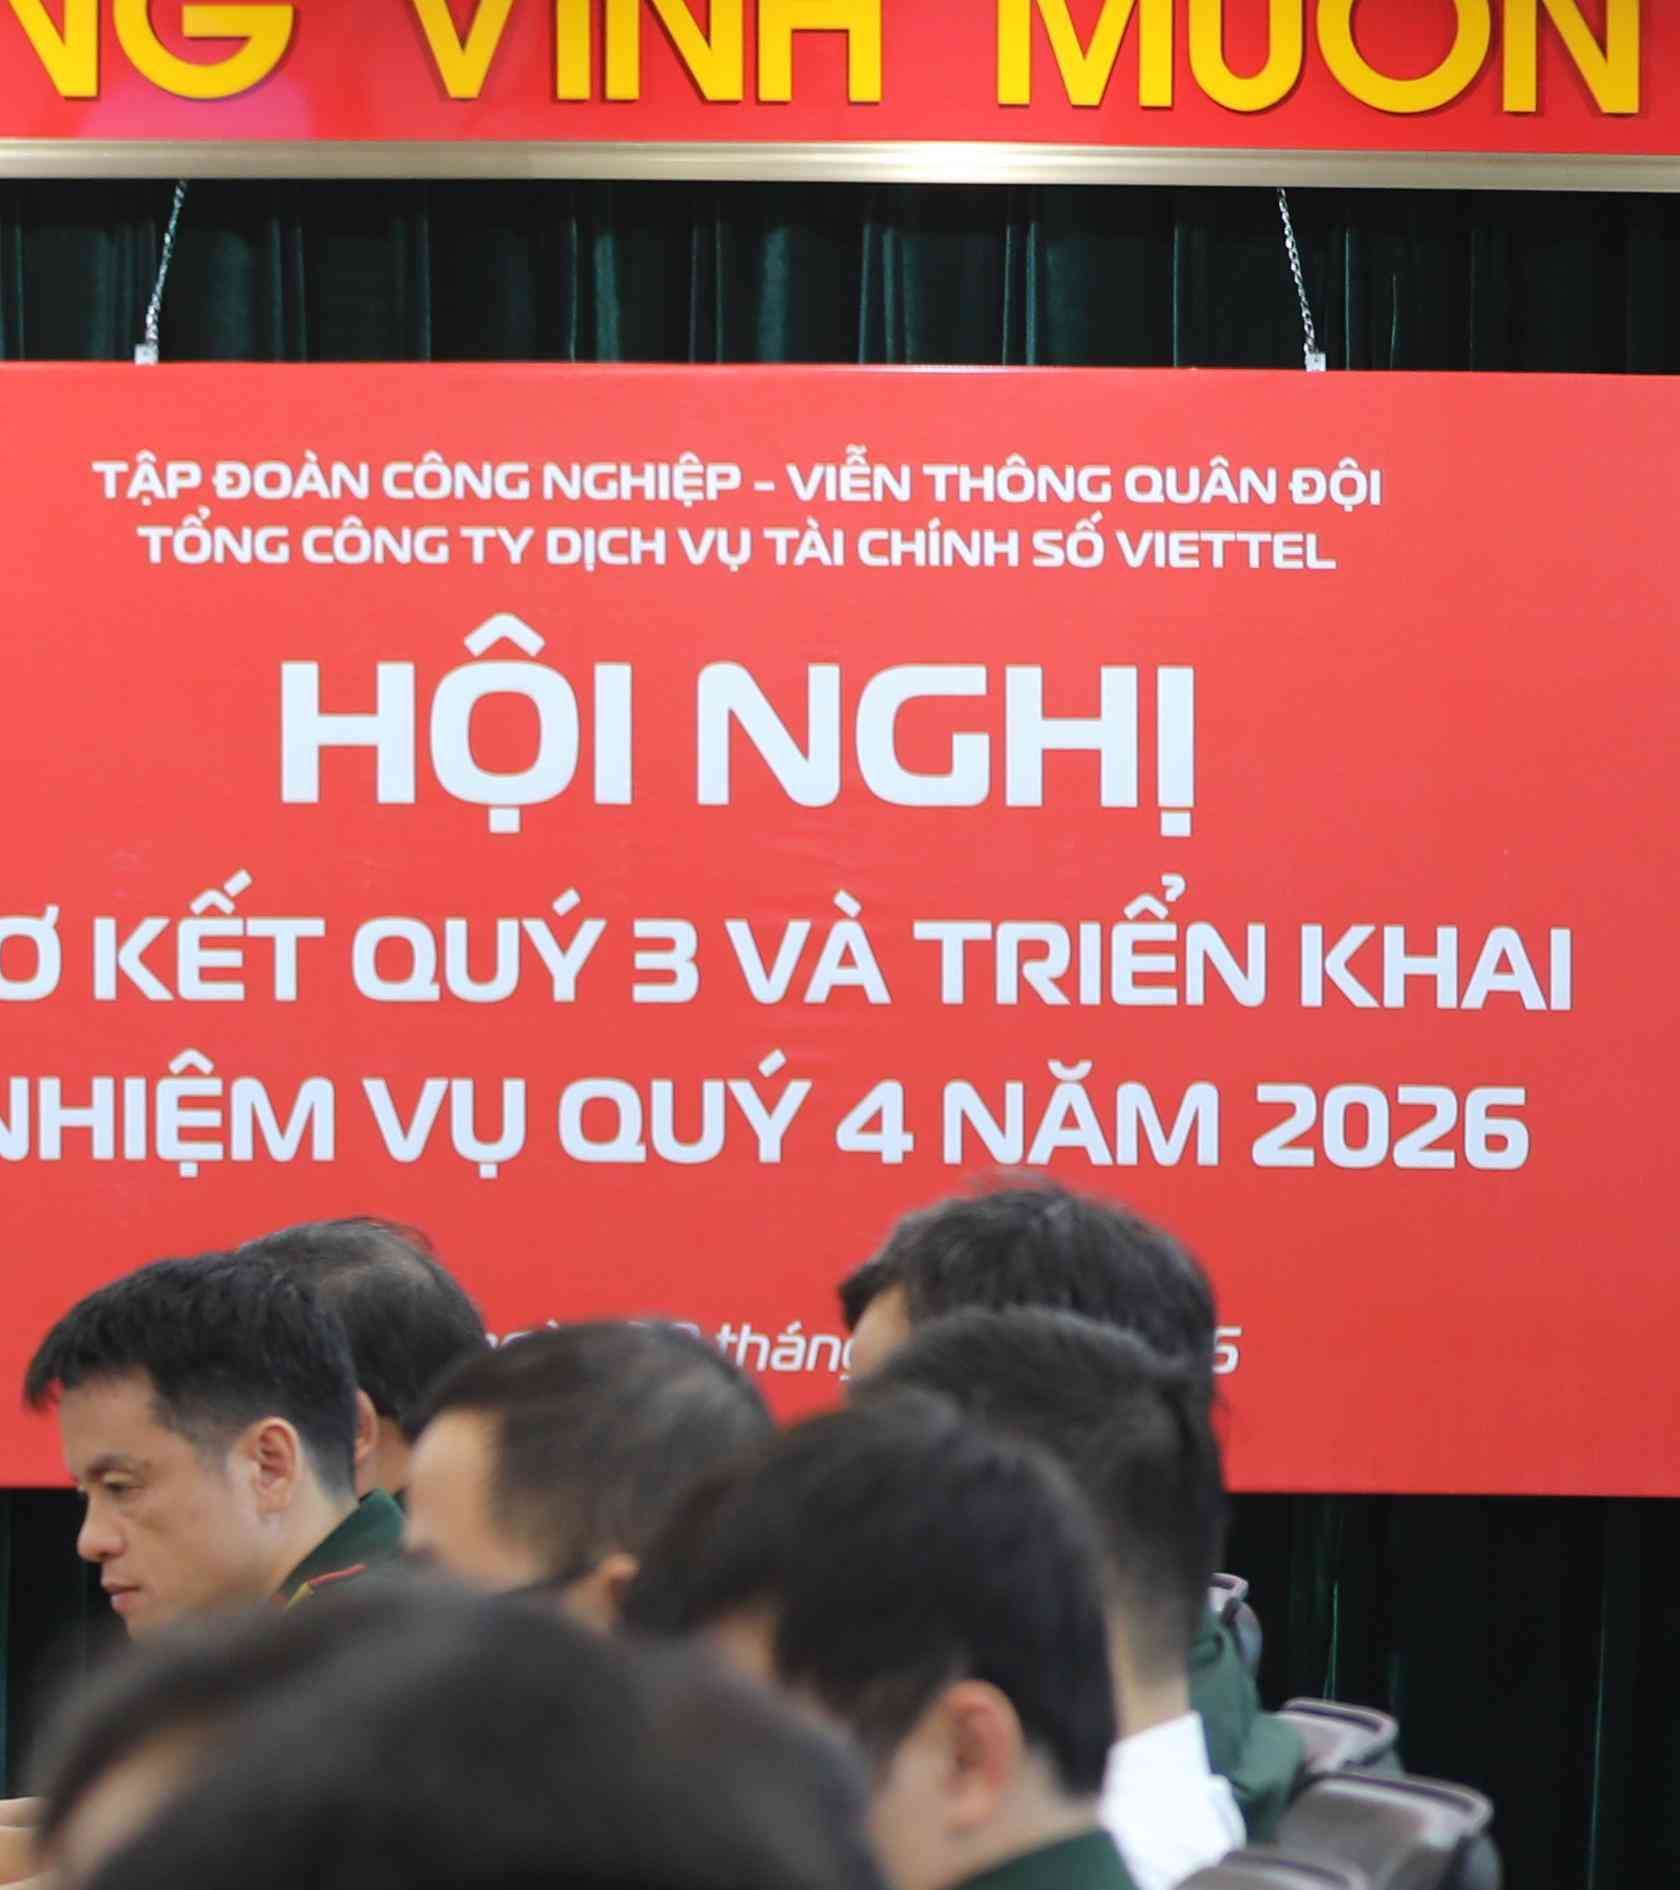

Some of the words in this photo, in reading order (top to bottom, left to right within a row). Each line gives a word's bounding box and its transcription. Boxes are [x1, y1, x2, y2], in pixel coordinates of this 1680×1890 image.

[91, 450, 203, 506] TẬP
[211, 449, 370, 500] ĐOÀN
[381, 449, 529, 500] CÔNG
[543, 450, 742, 507] NGHIỆP
[785, 443, 911, 503] VIỄN
[922, 452, 1112, 504] THÔNG
[1123, 455, 1277, 506] QUÂN
[1288, 457, 1382, 512] ĐỘI
[136, 505, 291, 565] TỔNG
[300, 514, 450, 565] CÔNG
[460, 526, 534, 565] TY
[545, 526, 666, 572] DỊCH
[676, 527, 752, 573] VỤ
[763, 517, 845, 567] TÀI
[857, 516, 1020, 568] CHÍNH
[1032, 511, 1106, 569] SỐ
[1115, 531, 1337, 570] VIETTEL
[280, 612, 634, 835] HỘI
[696, 660, 1196, 838] NGHỊ
[92, 869, 327, 1003] KẾT
[350, 888, 608, 1004] QUÝ
[631, 917, 700, 1004] 3
[724, 889, 892, 1005] VÀ
[912, 872, 1267, 1008] TRIỂN
[1300, 922, 1572, 1012] KHAI
[361, 1076, 527, 1180] VỤ
[557, 1048, 813, 1165] QUÝ
[834, 1079, 915, 1165] 4
[942, 1059, 1220, 1167] NĂM
[1251, 1082, 1530, 1171] 2026
